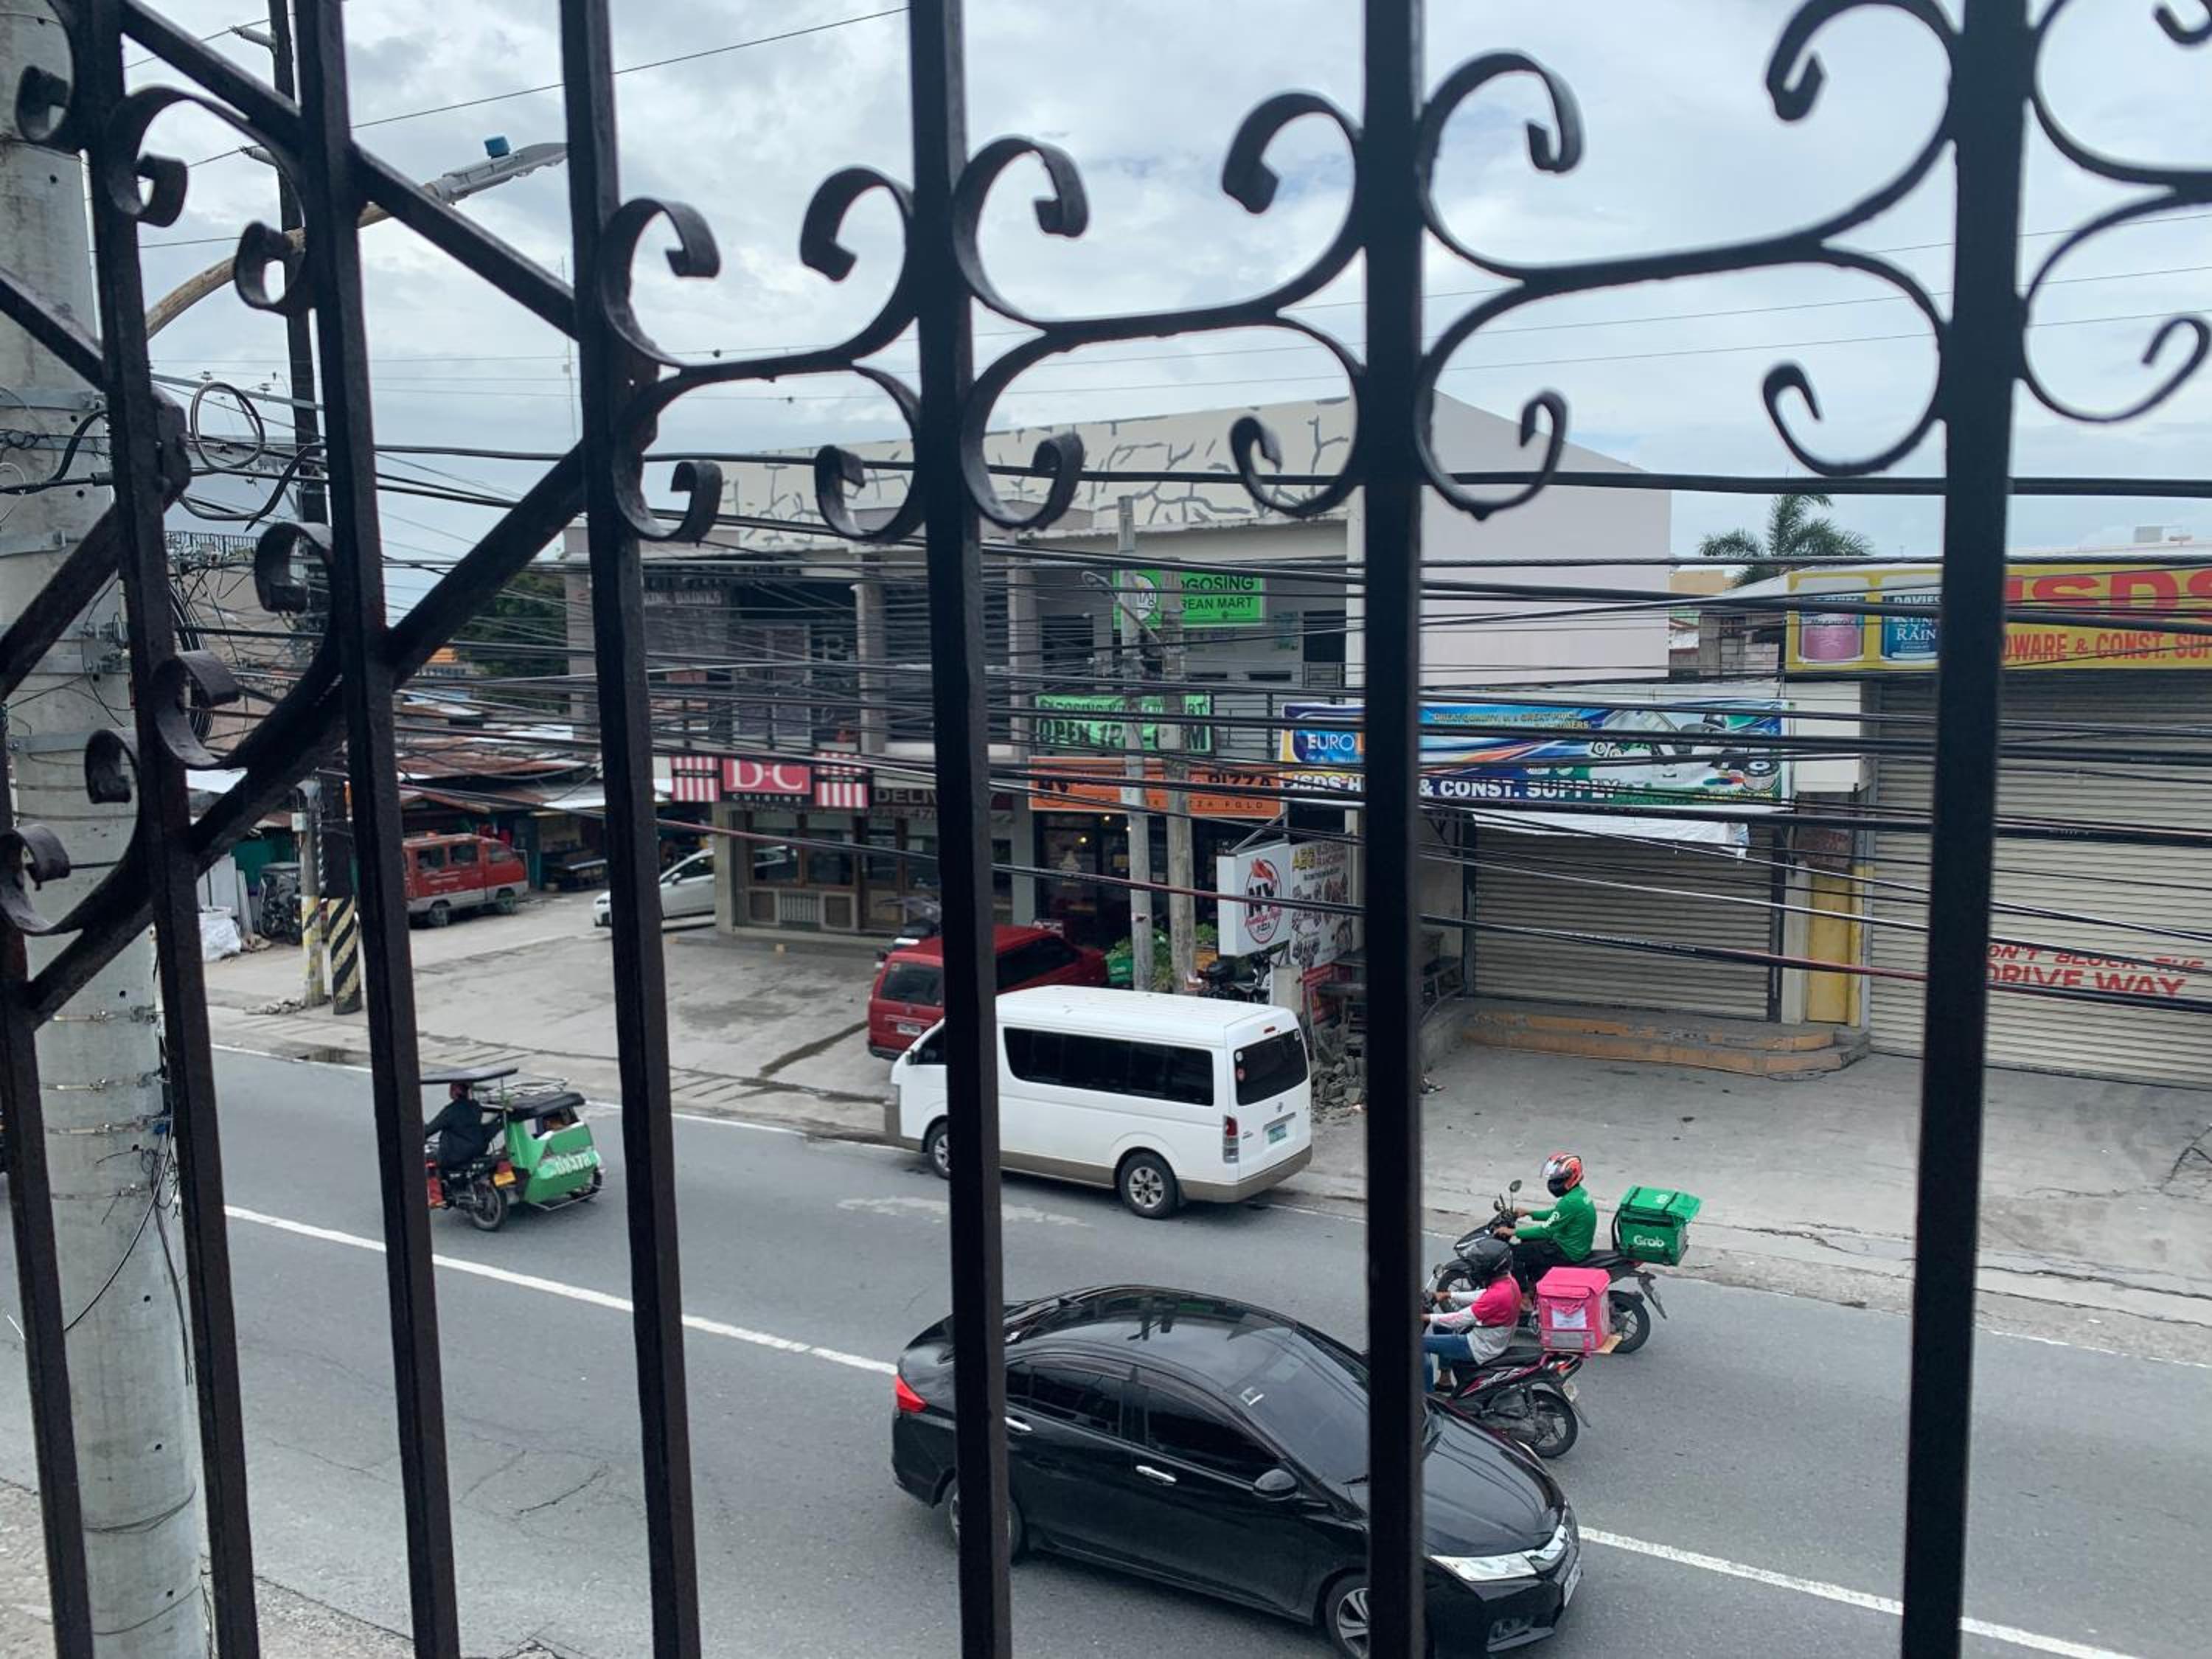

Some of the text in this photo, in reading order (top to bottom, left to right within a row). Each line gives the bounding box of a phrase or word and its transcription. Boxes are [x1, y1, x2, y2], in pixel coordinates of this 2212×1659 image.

[1218, 597, 1253, 609] MART
[1896, 628, 1936, 641] RAIN
[2075, 638, 2089, 655] &
[2096, 633, 2167, 659] CONST.
[1419, 779, 1619, 799] & CONST. SUPPLY
[2095, 971, 2186, 998] WAY
[1633, 1235, 1665, 1248] Grab
